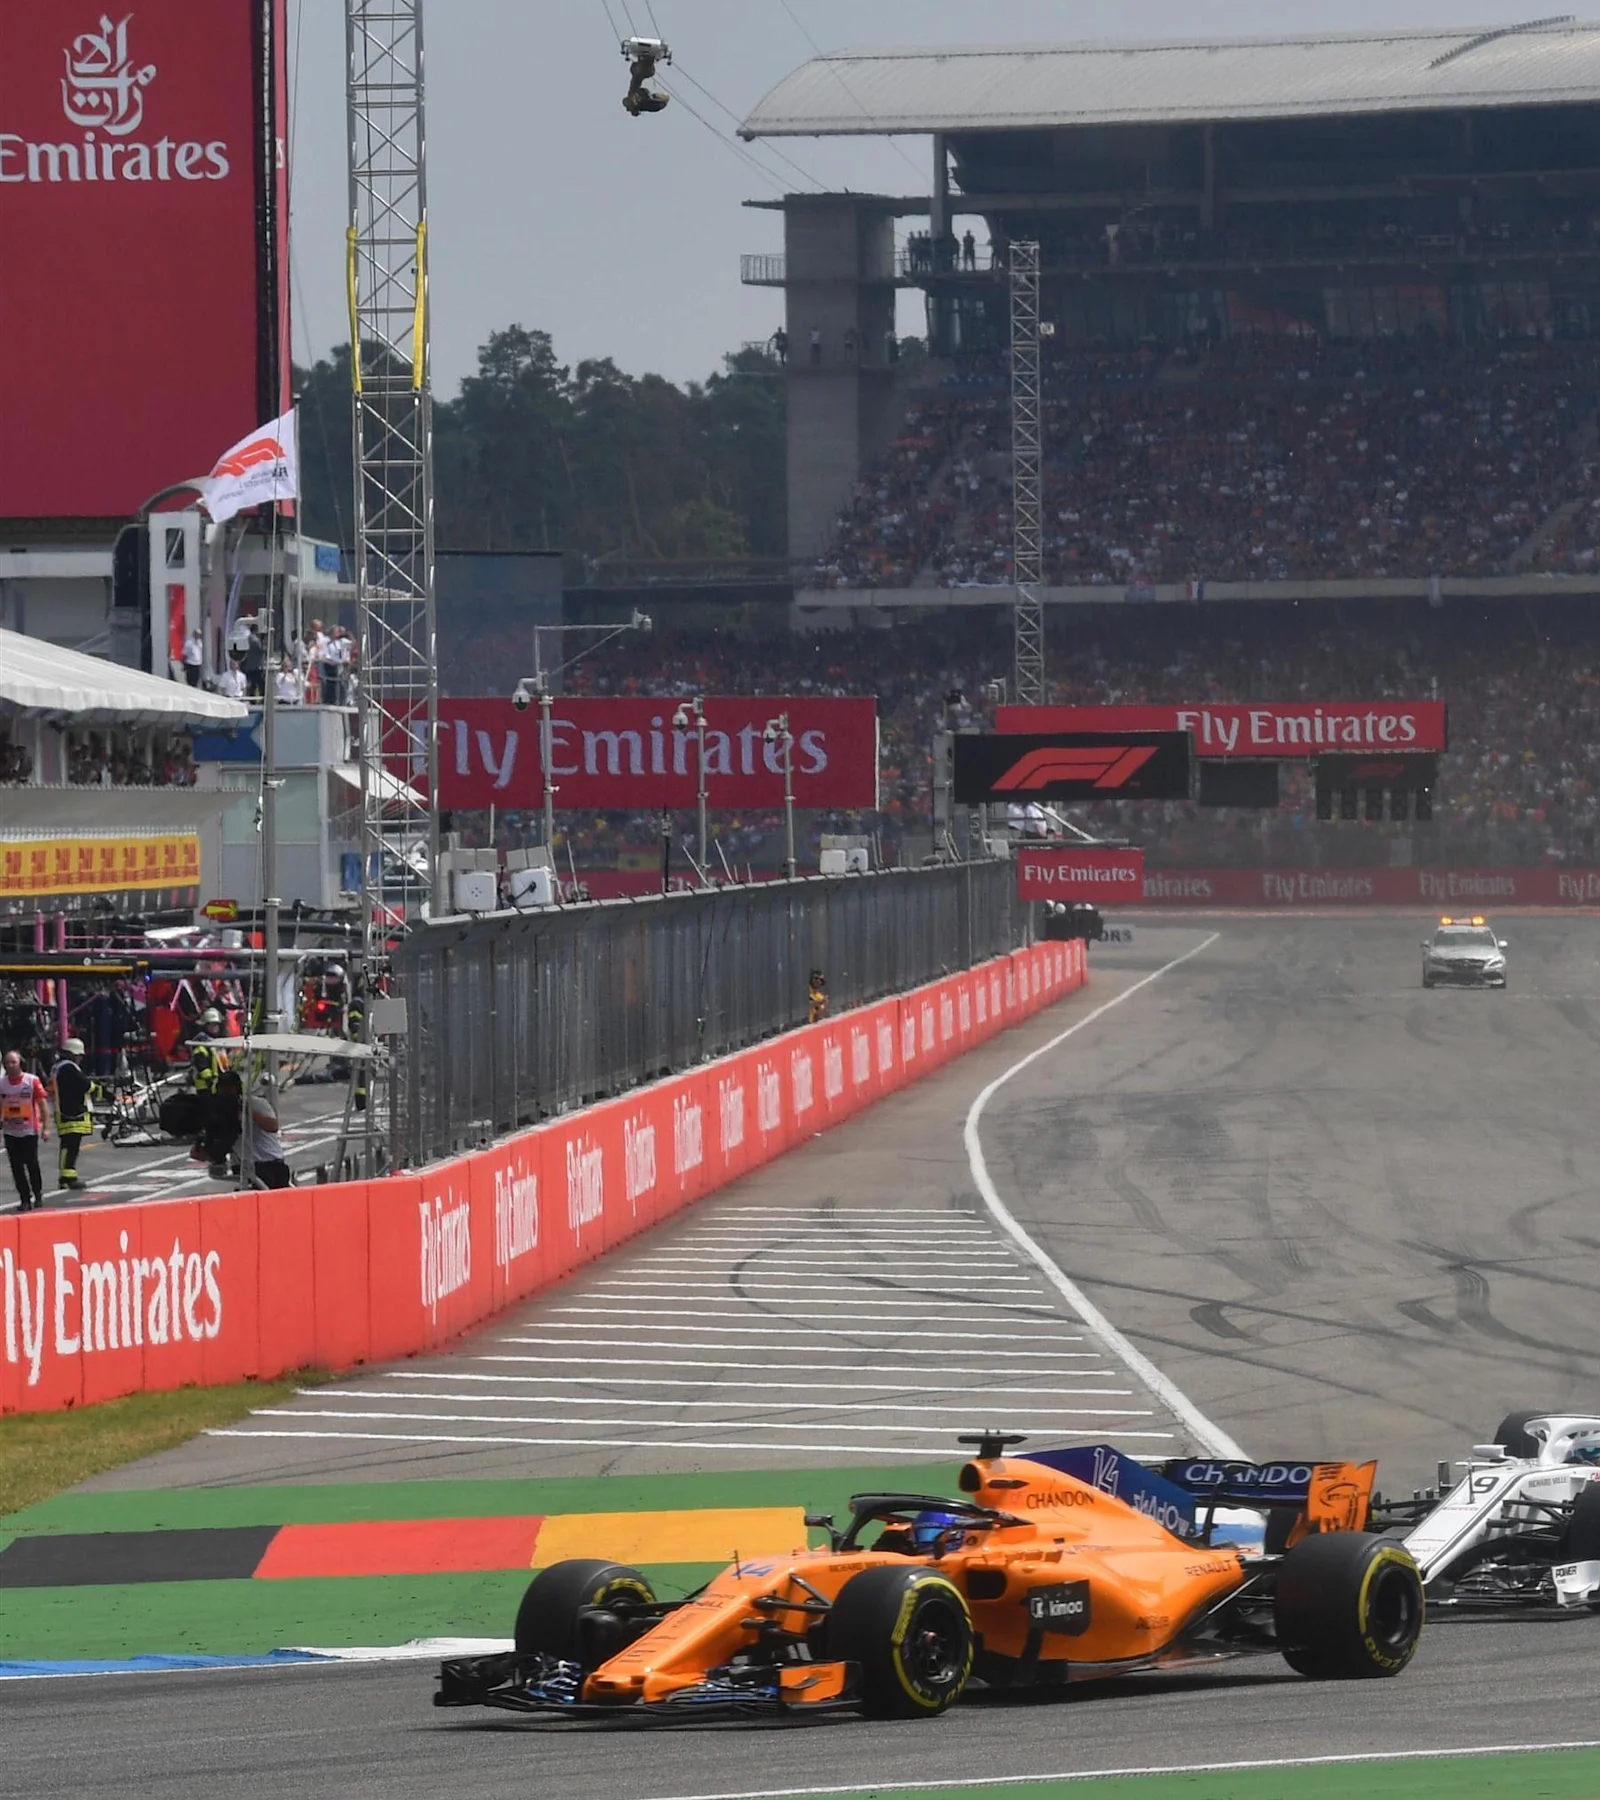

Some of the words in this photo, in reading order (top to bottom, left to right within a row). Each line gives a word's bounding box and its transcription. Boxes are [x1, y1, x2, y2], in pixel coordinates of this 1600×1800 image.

[0, 131, 230, 183] Emirates
[1250, 708, 1417, 744] Emirates
[412, 718, 519, 789] Fly
[537, 715, 828, 776] Emirates
[1024, 865, 1055, 884] Fly
[1058, 864, 1137, 883] Emirates
[0, 1246, 45, 1387] ly
[53, 1230, 223, 1356] Emirates
[1185, 1463, 1311, 1484] CHNDO
[1472, 1476, 1500, 1494] 9
[1026, 1490, 1095, 1509] CHANDON
[1184, 1559, 1233, 1578] RENAULT
[1050, 1600, 1083, 1617] kimoa
